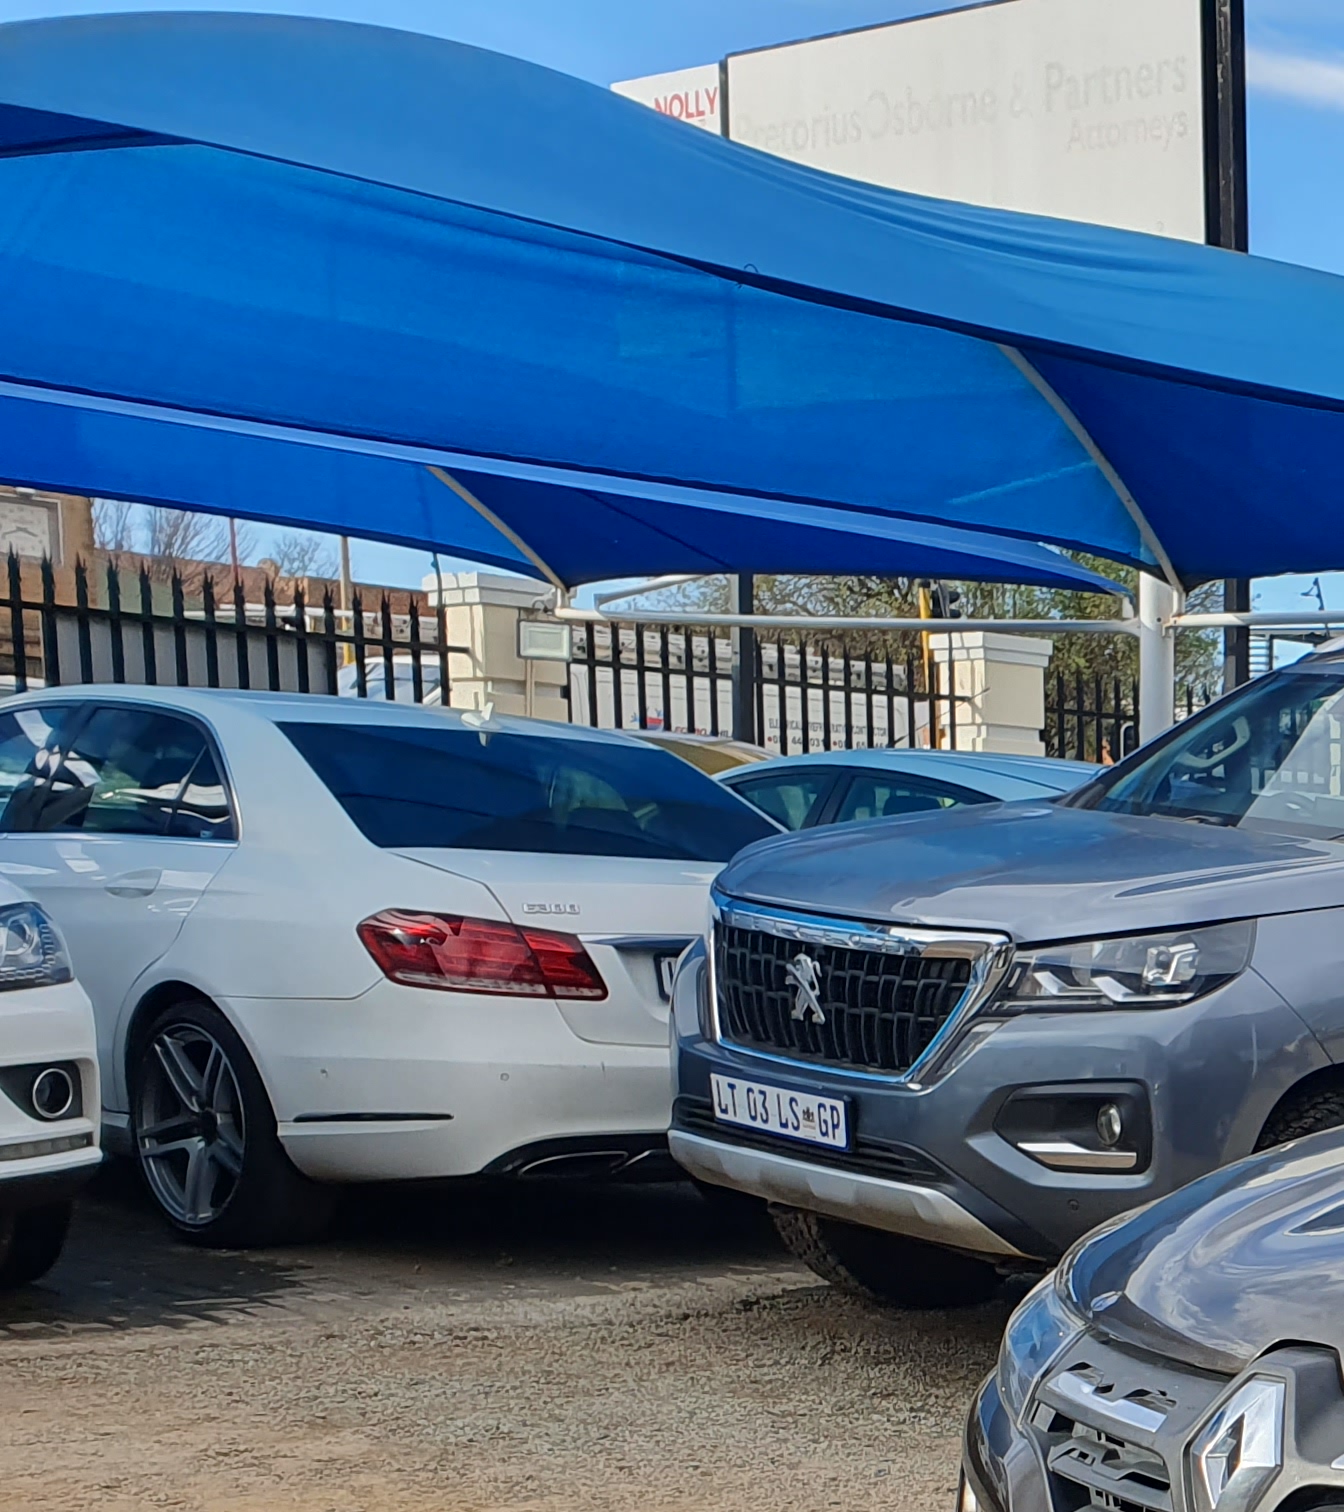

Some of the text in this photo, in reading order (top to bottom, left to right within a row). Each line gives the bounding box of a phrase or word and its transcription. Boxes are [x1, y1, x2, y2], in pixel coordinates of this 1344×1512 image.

[654, 86, 718, 120] NOLLY
[1044, 55, 1187, 112] Partners
[1067, 111, 1188, 152] Attorneys
[716, 1079, 841, 1141] LT 03 LS GP
